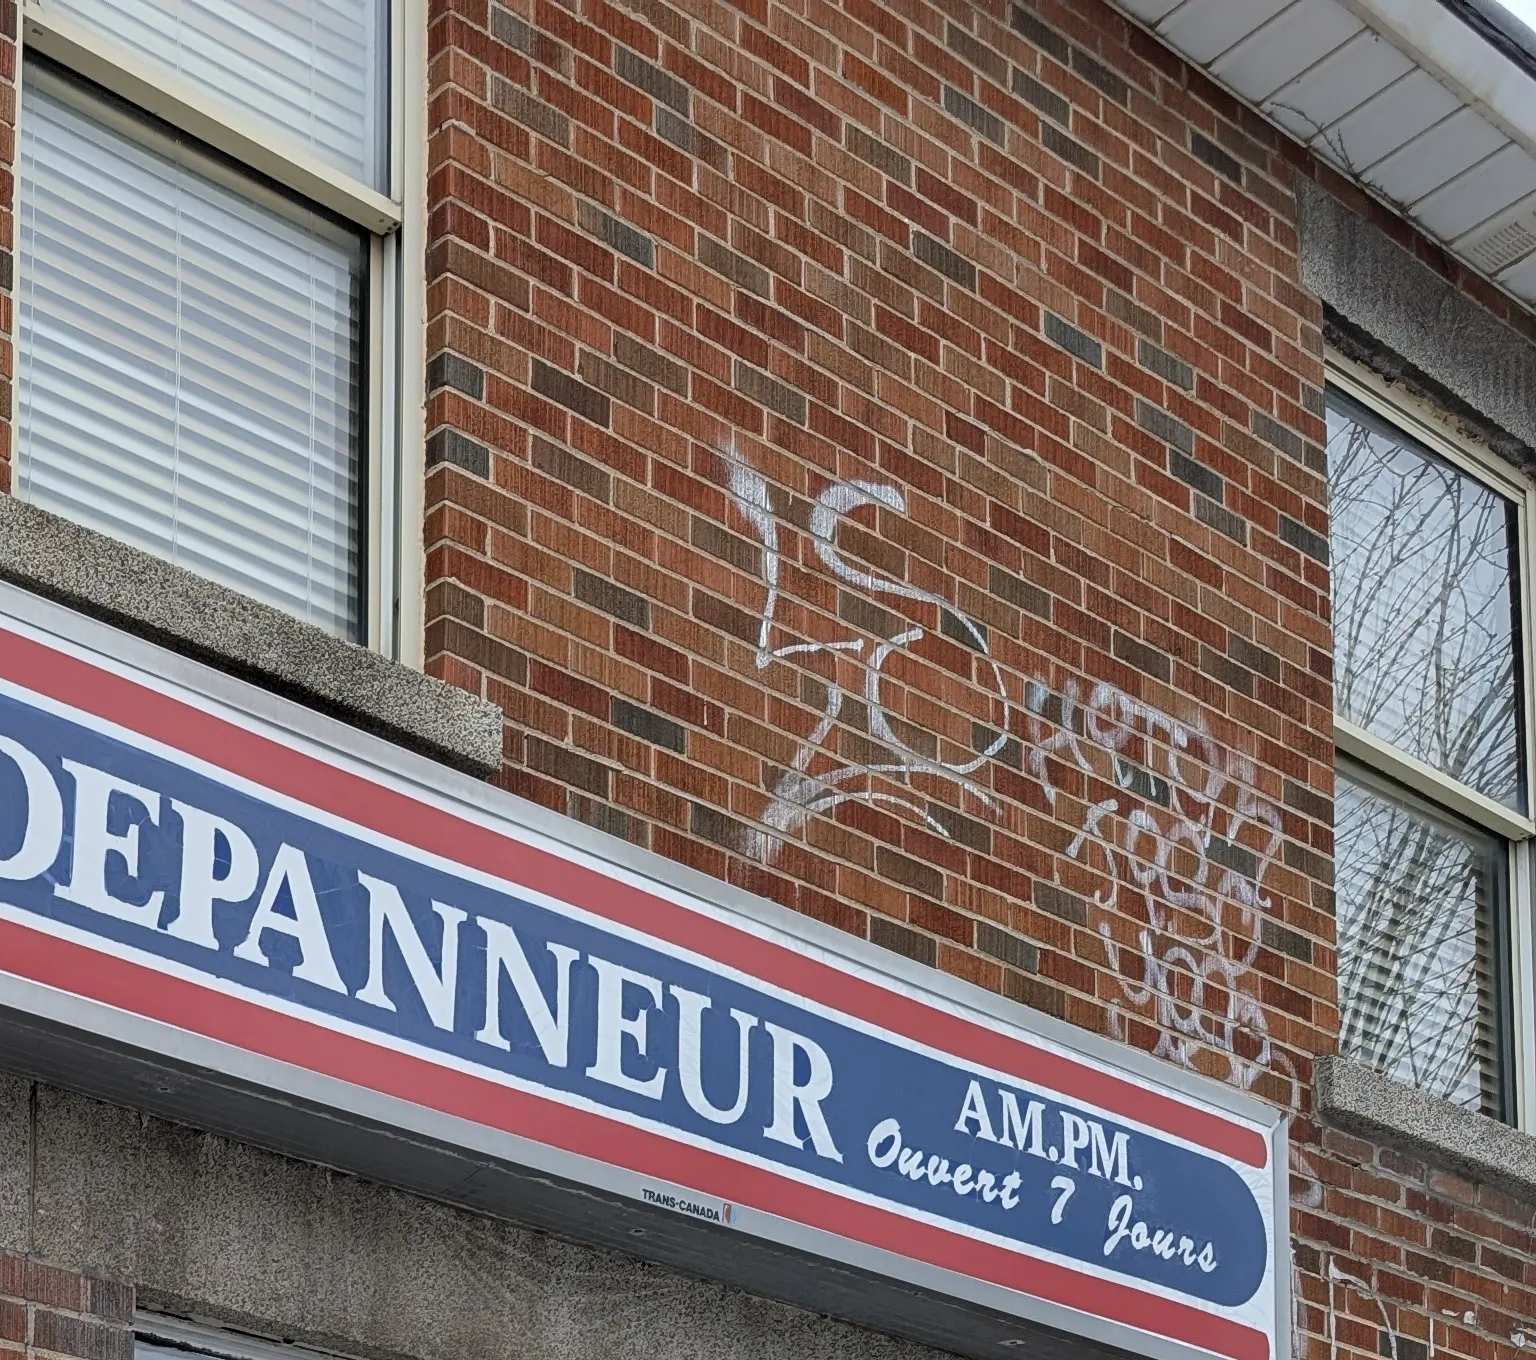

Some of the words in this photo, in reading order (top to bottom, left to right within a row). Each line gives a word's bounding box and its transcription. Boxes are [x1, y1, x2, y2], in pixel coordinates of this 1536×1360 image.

[867, 1118, 1023, 1210] Ouvert
[1051, 1175, 1075, 1224] 7
[1104, 1195, 1217, 1273] Jours
